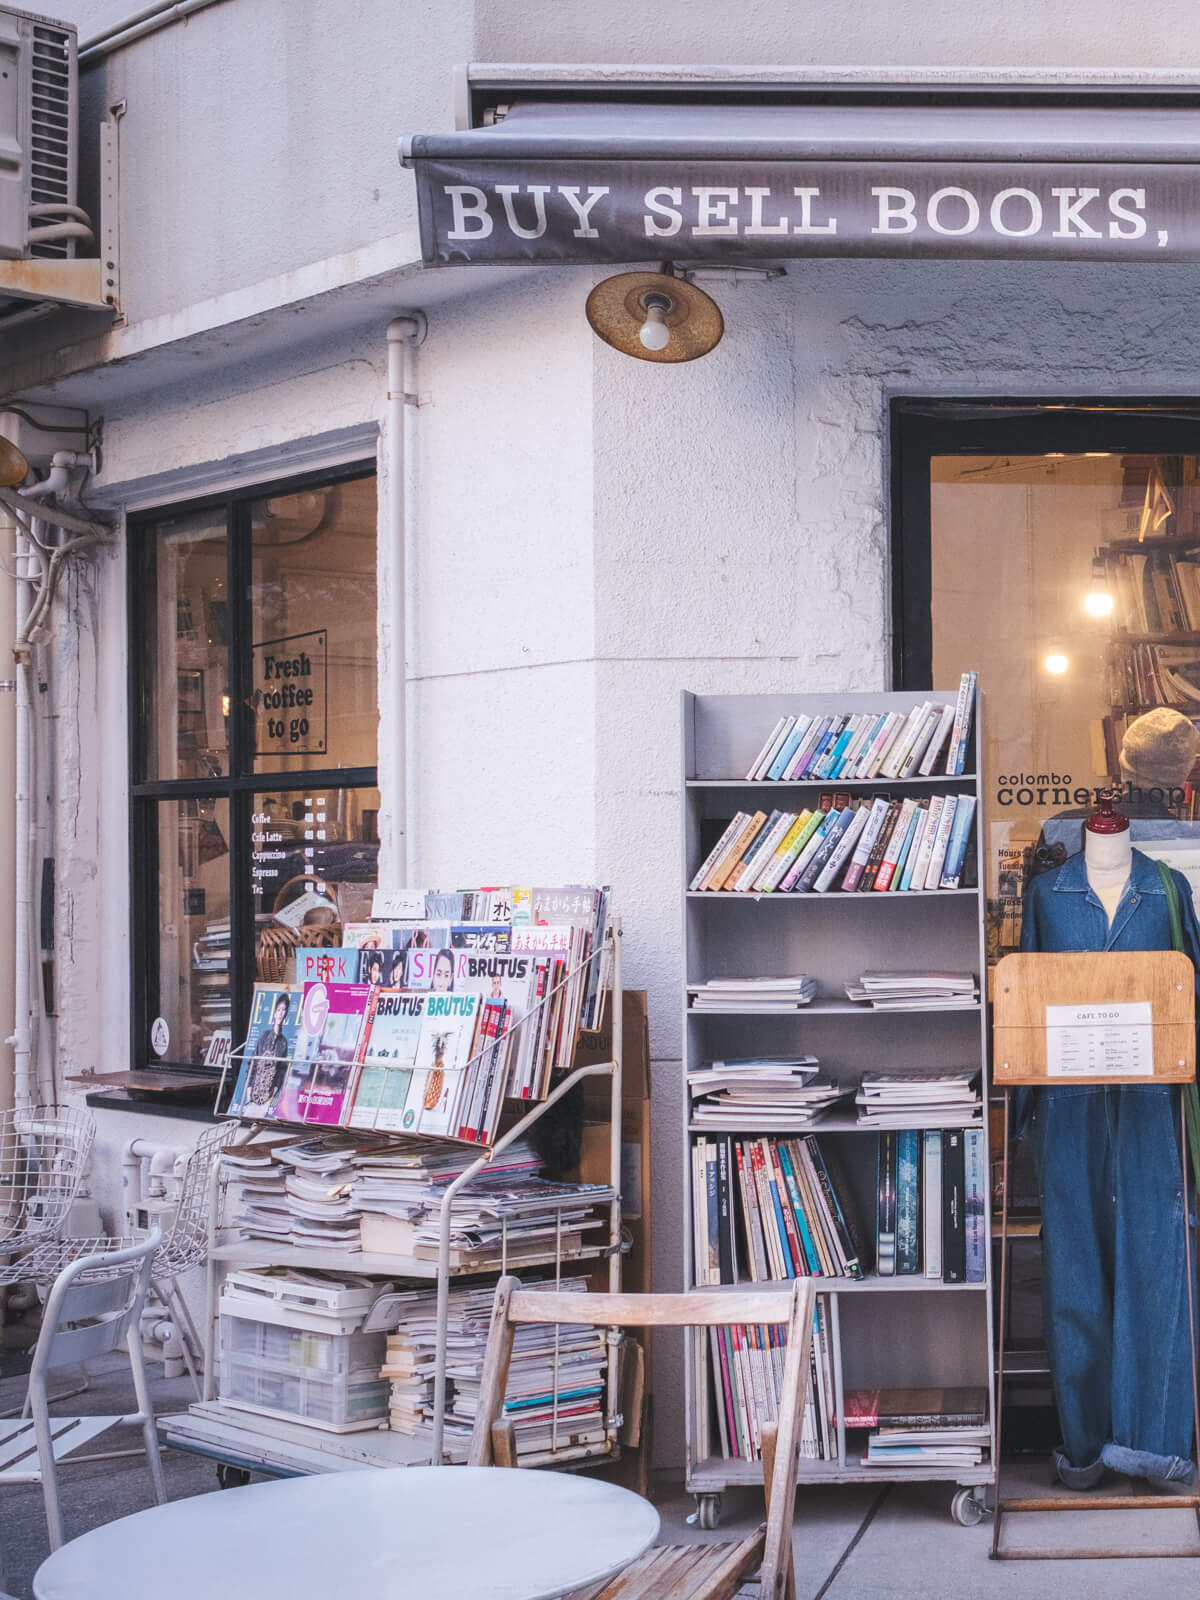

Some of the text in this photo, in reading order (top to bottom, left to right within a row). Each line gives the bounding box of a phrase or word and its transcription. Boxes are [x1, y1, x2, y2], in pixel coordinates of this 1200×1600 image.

[443, 183, 612, 241] BUY
[641, 186, 844, 238] SELL
[871, 186, 1170, 248] BOOKS,
[264, 652, 312, 680] Fresh
[263, 683, 313, 710] coffee
[268, 718, 310, 742] to go
[997, 772, 1072, 786] colombo
[305, 956, 347, 977] PERK
[413, 953, 467, 979] SPR
[468, 957, 529, 979] BRUTUS
[376, 996, 424, 1017] BRUTUS
[427, 996, 476, 1017] BRUTUS
[209, 1037, 232, 1066] OPE
